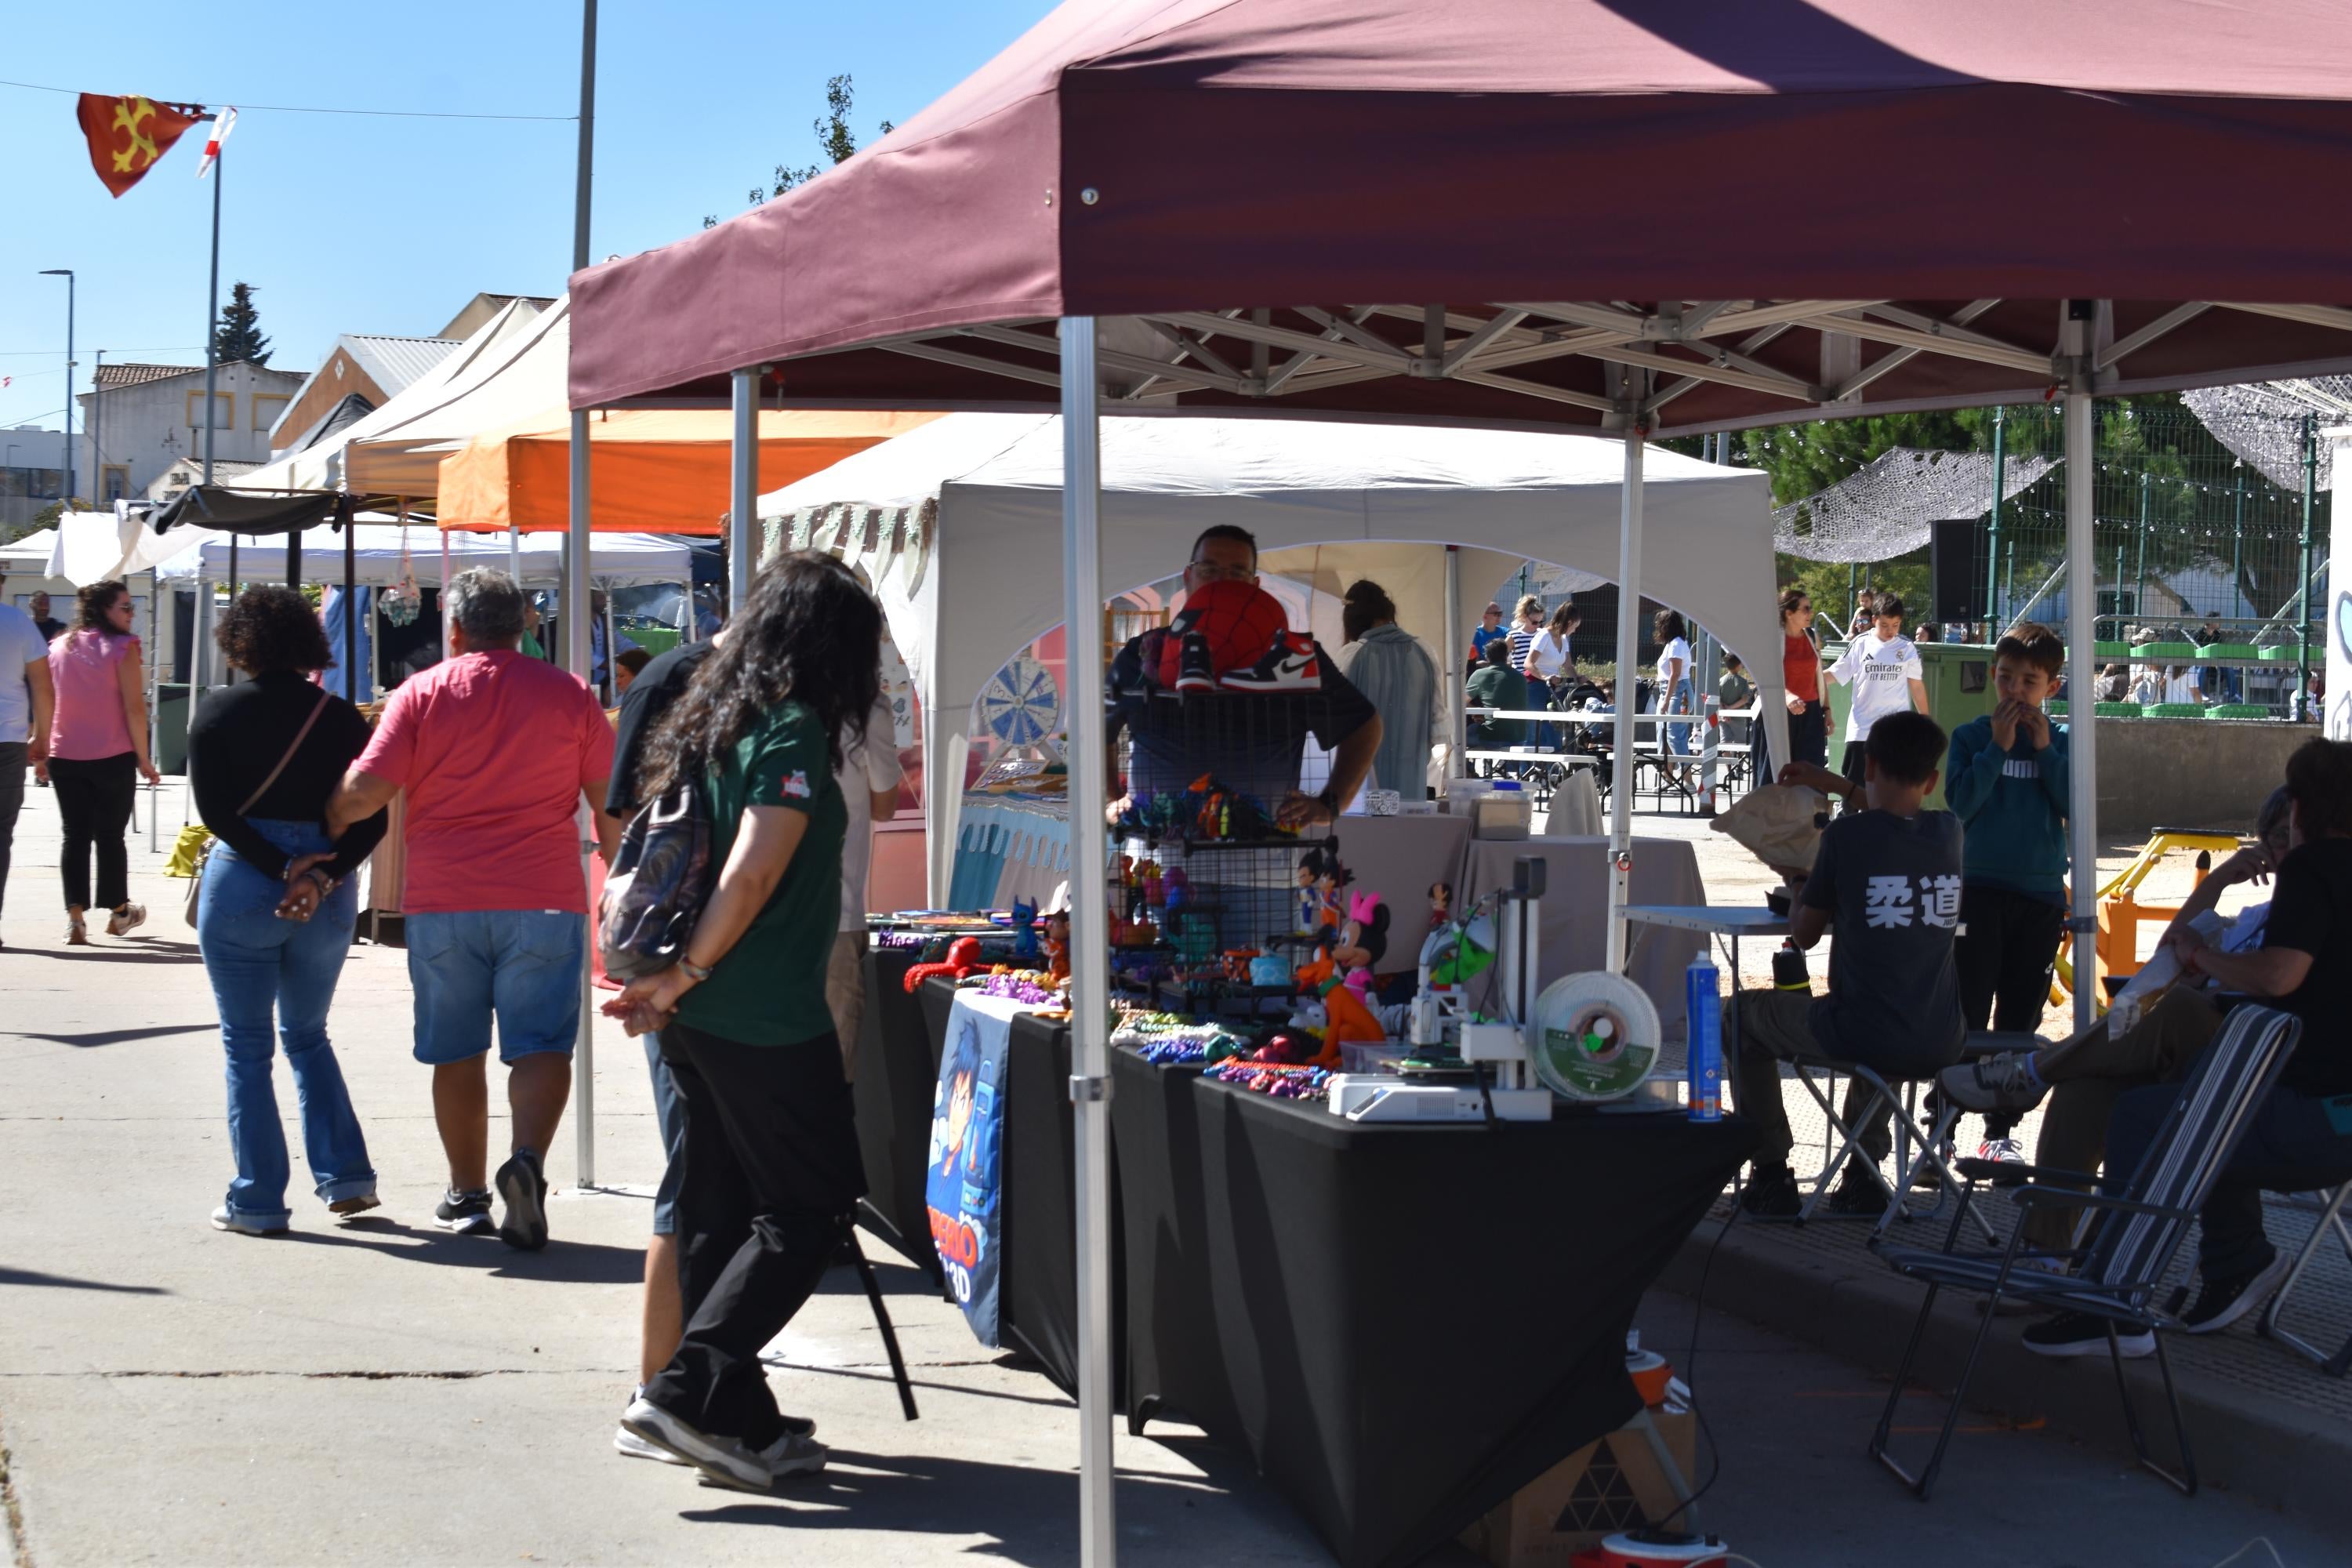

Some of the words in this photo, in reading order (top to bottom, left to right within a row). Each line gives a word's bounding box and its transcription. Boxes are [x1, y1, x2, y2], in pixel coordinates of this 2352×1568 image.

[1865, 662, 1903, 673] Emirates
[1865, 874, 1960, 928] 柔道
[927, 1204, 978, 1268] PERIO
